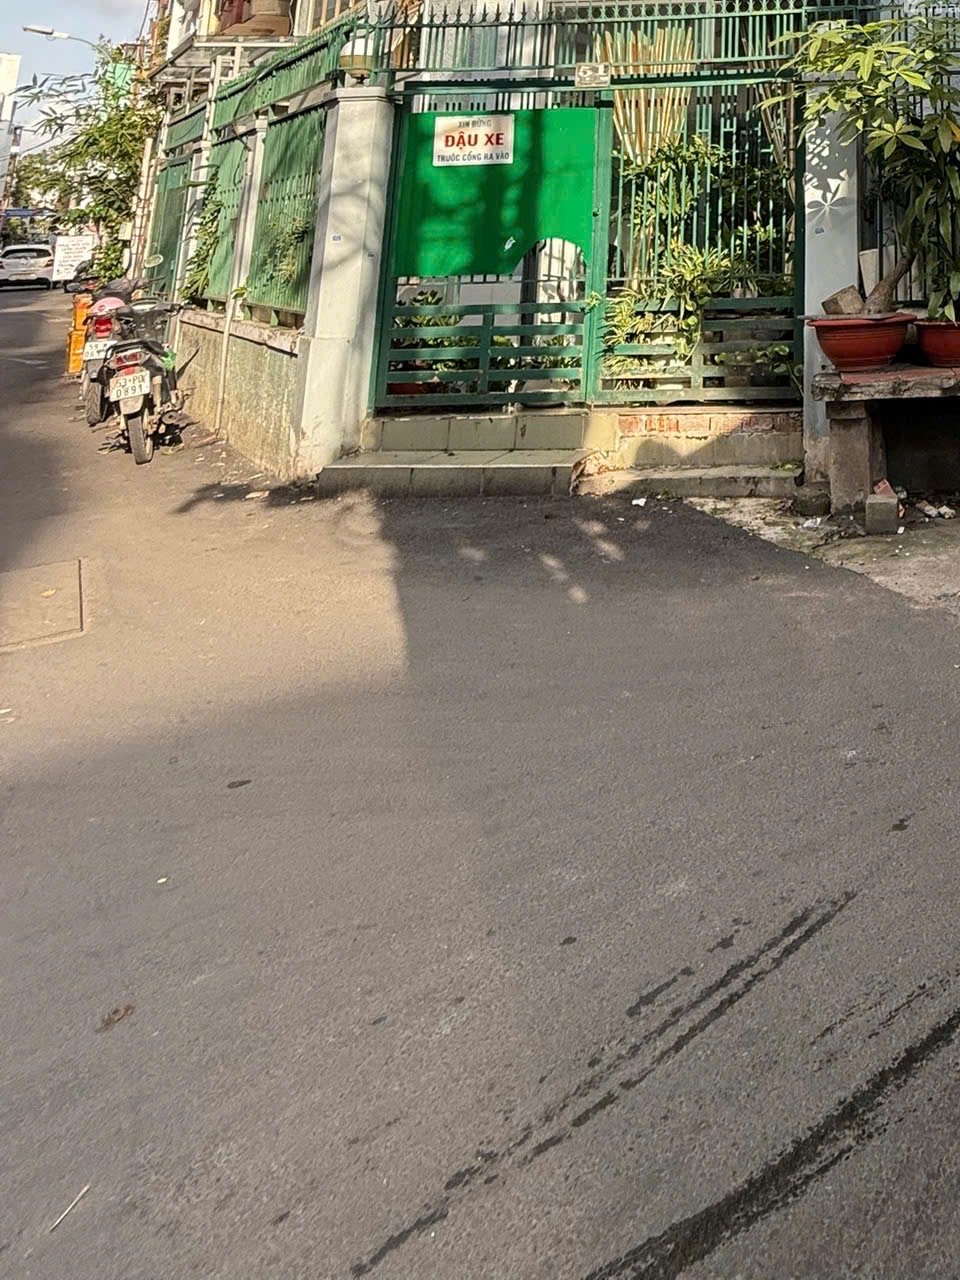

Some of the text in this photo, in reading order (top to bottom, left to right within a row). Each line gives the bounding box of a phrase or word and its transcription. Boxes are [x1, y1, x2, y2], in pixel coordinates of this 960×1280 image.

[444, 130, 505, 150] ĐẬU XE
[483, 152, 494, 161] RA
[495, 151, 510, 160] VÀO
